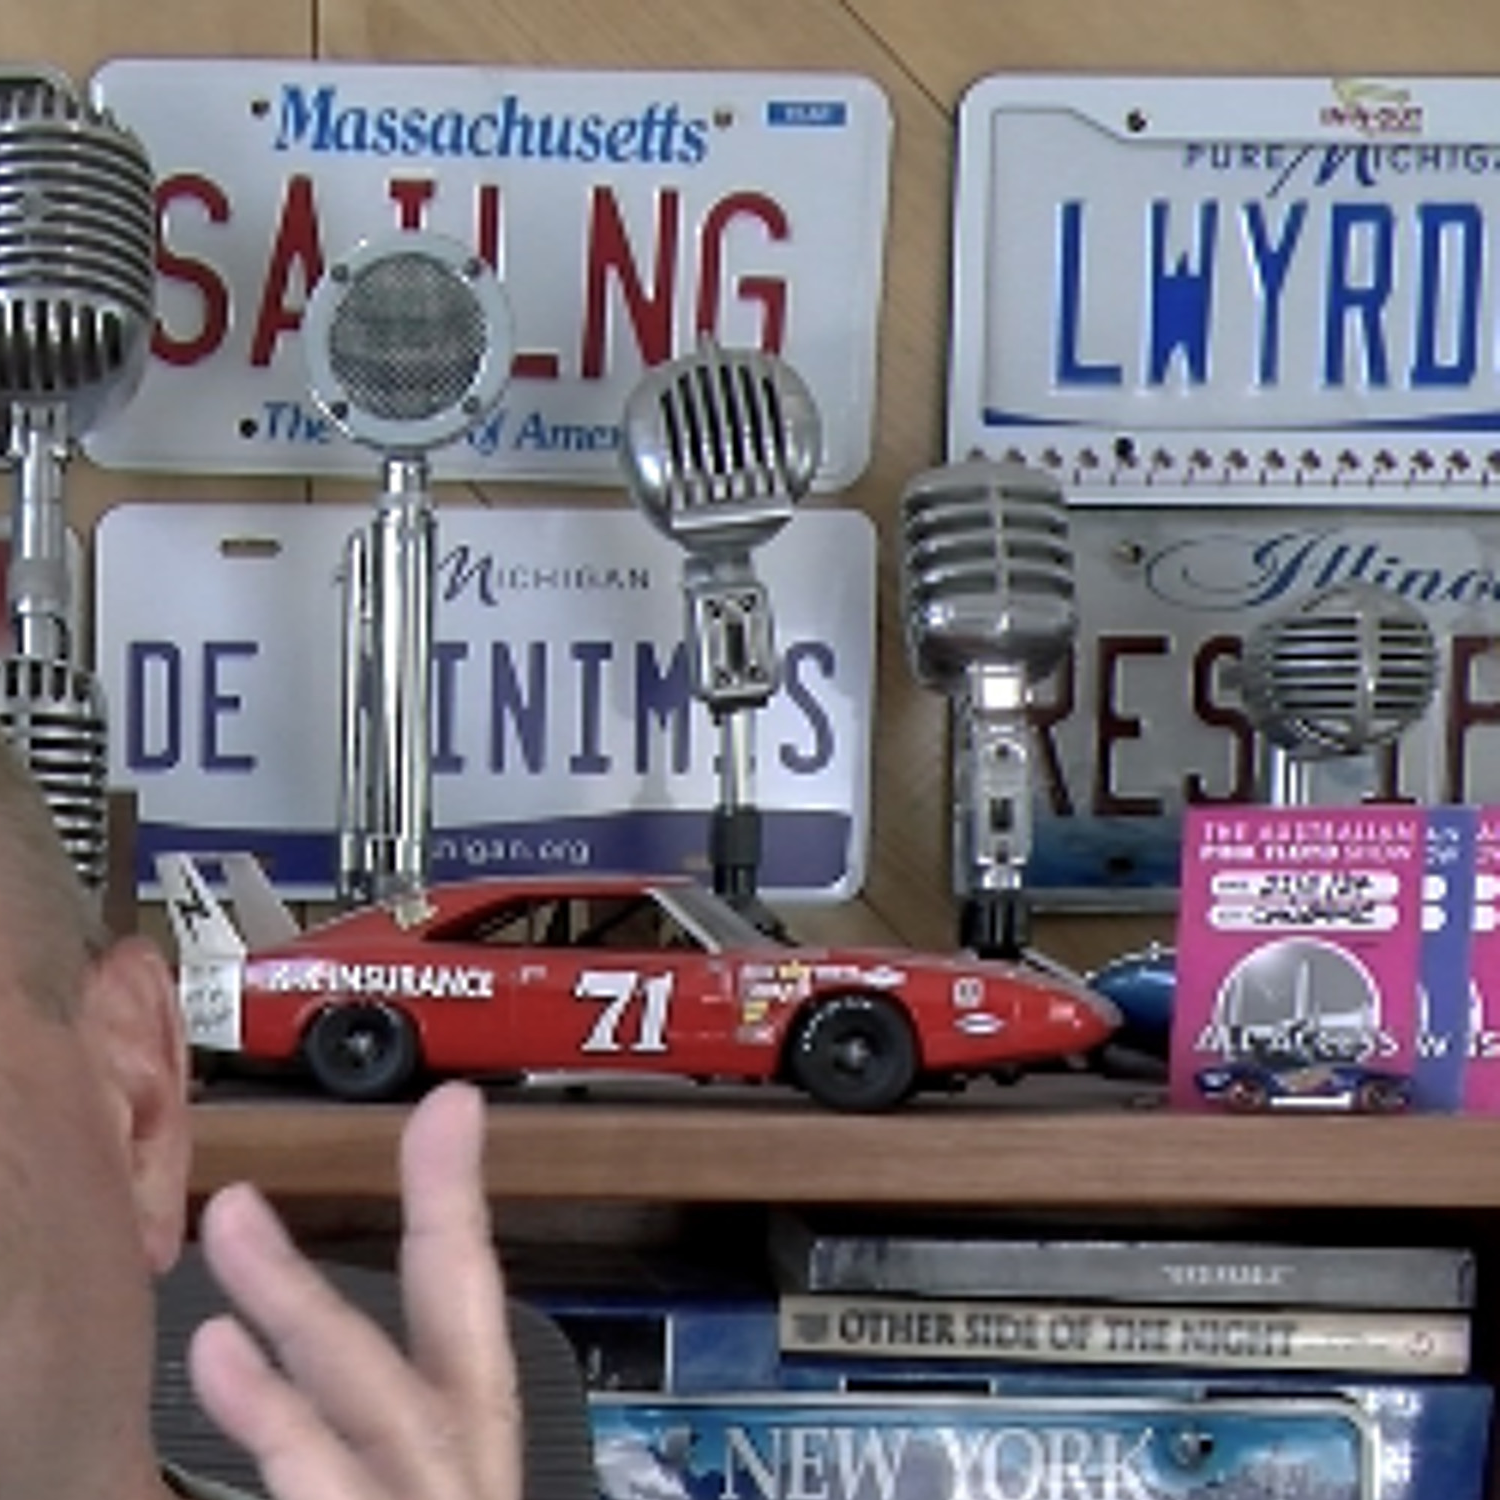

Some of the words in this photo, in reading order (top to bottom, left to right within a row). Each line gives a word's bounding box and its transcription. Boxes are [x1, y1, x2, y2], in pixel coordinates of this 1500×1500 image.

[273, 86, 708, 164] Massachusetts
[1314, 144, 1500, 187] MICHIG
[149, 174, 790, 378] SALNG
[1055, 200, 1485, 387] LWYRD
[126, 641, 258, 773] DE
[362, 641, 835, 774] INIMS
[574, 970, 674, 1052] 71
[838, 1310, 956, 1347] OTHER
[965, 1312, 1042, 1349] SIDE
[1048, 1313, 1093, 1350] OF
[1103, 1316, 1173, 1353] THE
[1180, 1319, 1298, 1357] NIGHT
